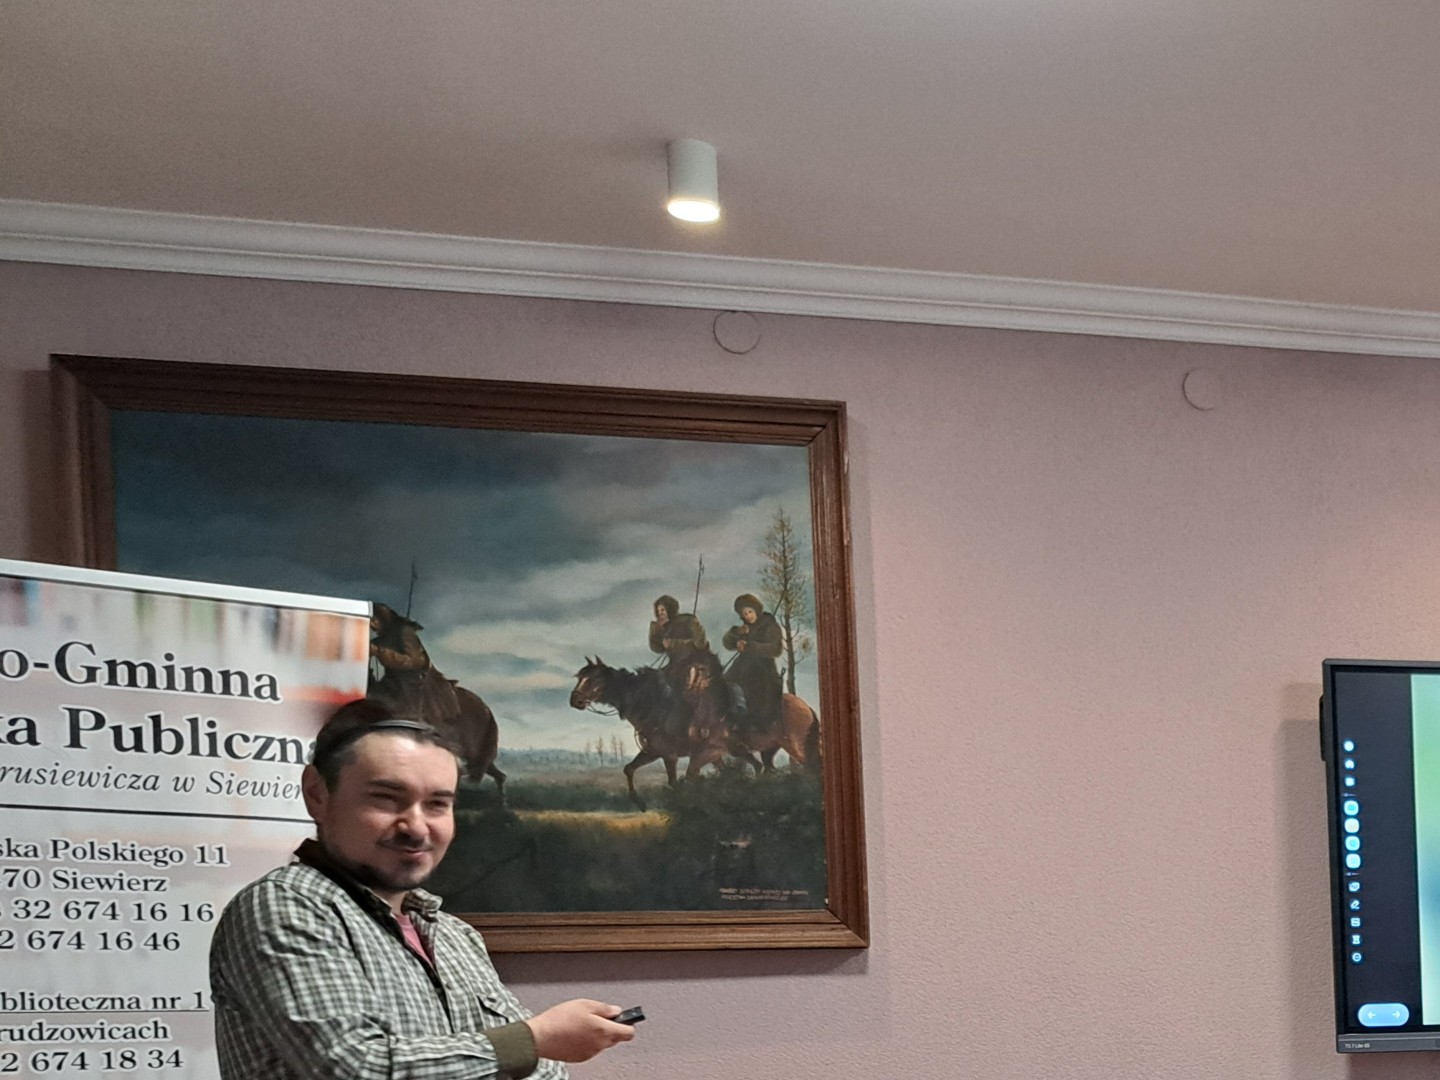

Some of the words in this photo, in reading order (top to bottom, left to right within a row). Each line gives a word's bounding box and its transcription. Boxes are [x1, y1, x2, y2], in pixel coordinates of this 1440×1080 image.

[0, 641, 280, 701] o-Gminna
[0, 762, 160, 791] rusiewicza
[172, 776, 195, 793] w
[0, 838, 39, 858] ka
[50, 839, 183, 867] Polskiego
[196, 845, 228, 865] 11
[53, 869, 167, 892] Siewierz
[13, 899, 51, 919] 32
[64, 900, 120, 920] 674
[133, 902, 167, 921] 16
[180, 903, 214, 922] 16
[27, 930, 86, 950] 674
[98, 931, 133, 951] 16
[143, 932, 180, 951] 46
[0, 991, 141, 1011] blioteczna
[152, 995, 181, 1009] nr
[193, 991, 207, 1009] 1
[1, 1052, 19, 1072] 2
[31, 1051, 90, 1072] 674
[102, 1050, 137, 1070] 18
[147, 1049, 184, 1069] 34
